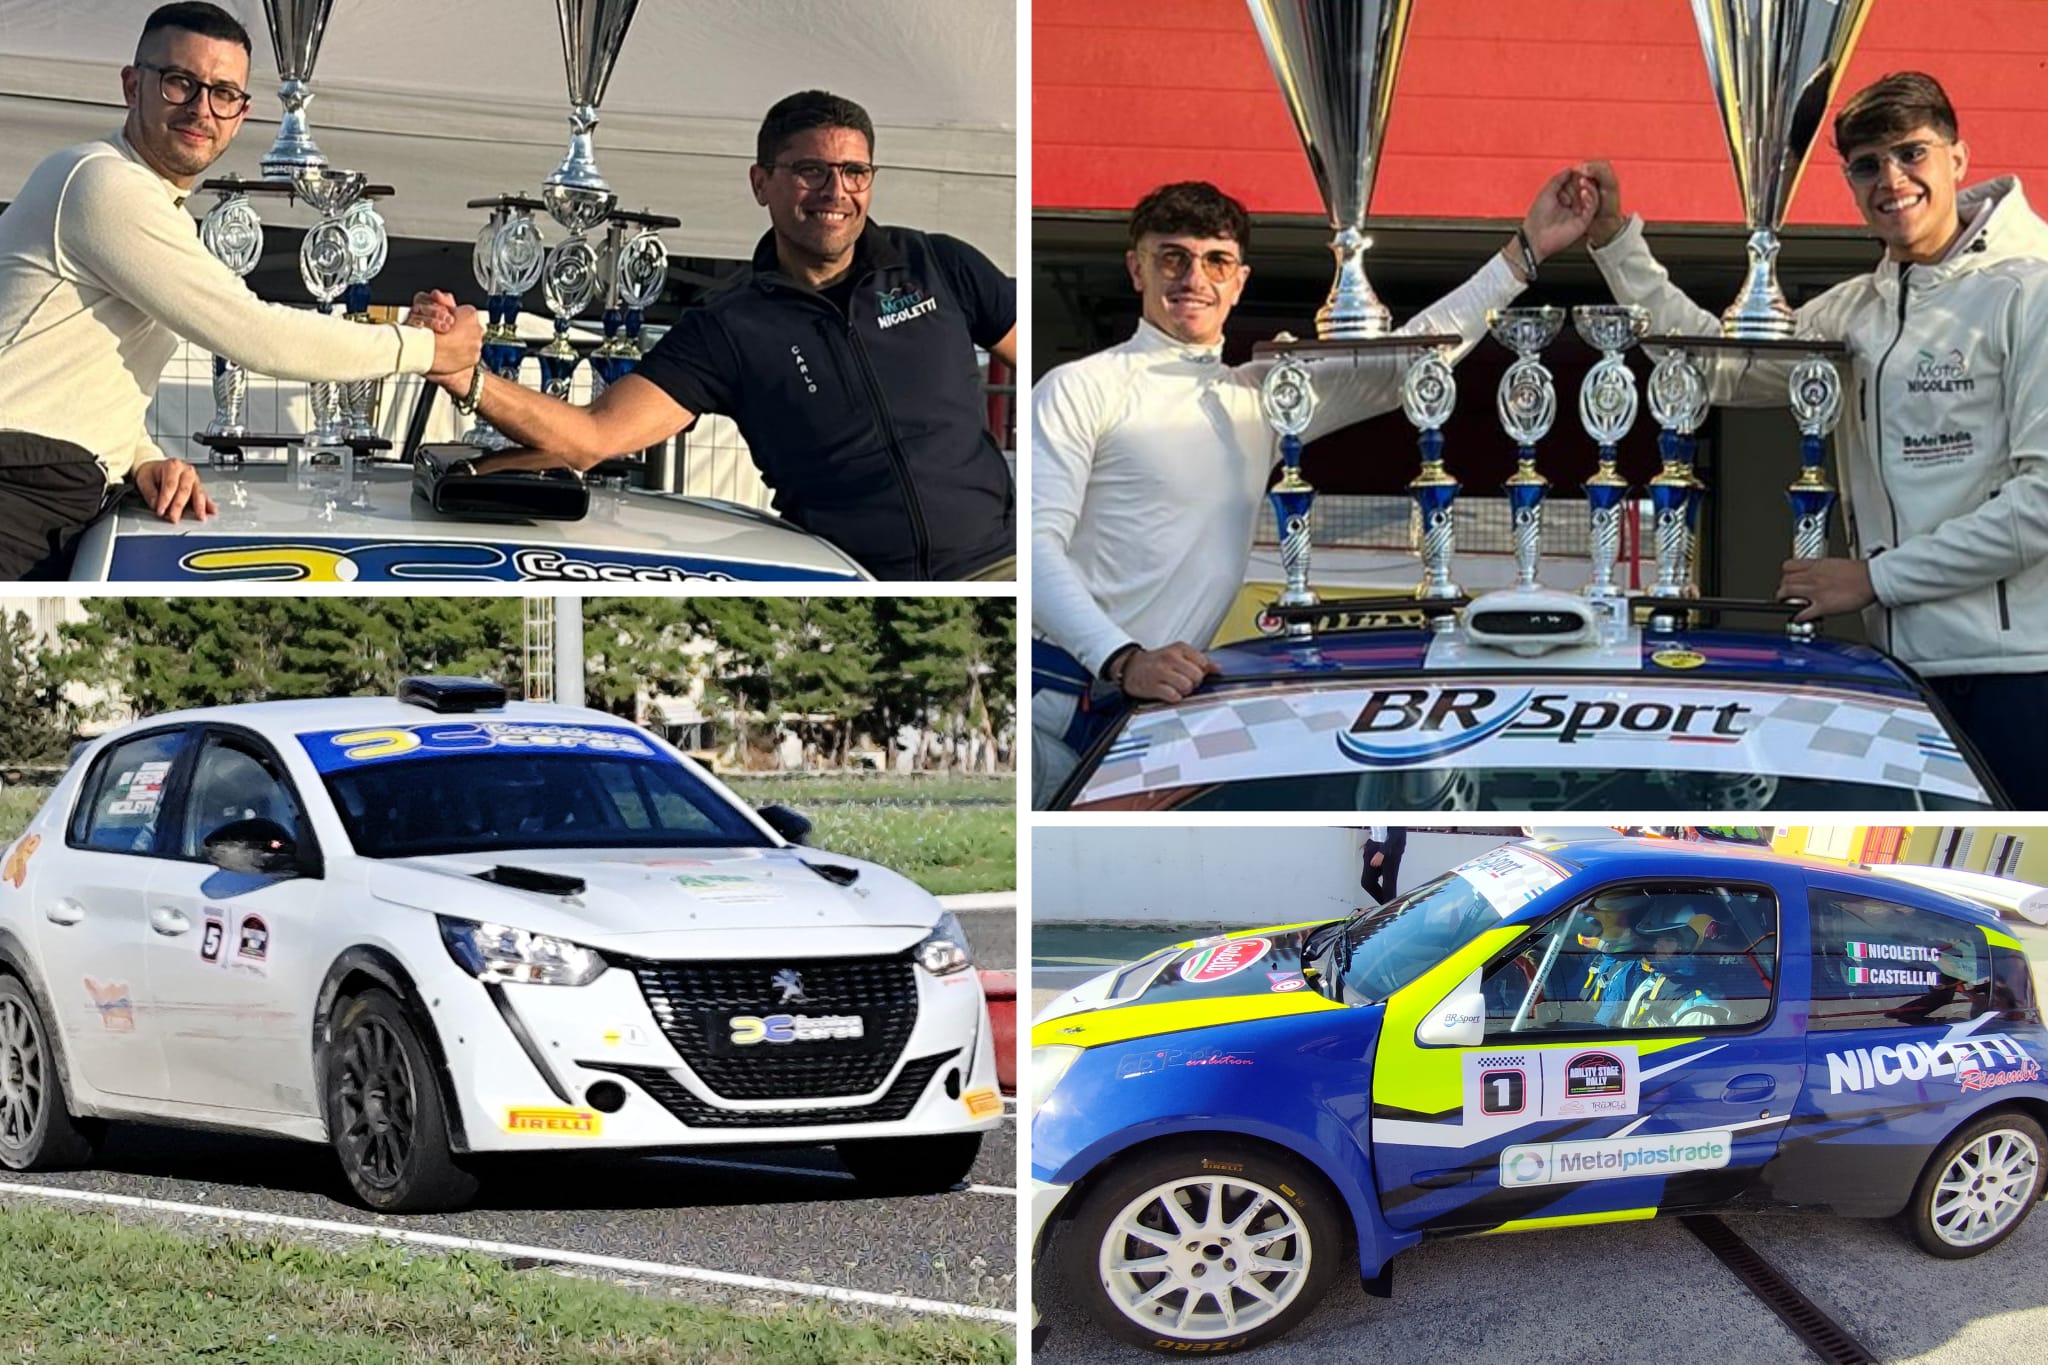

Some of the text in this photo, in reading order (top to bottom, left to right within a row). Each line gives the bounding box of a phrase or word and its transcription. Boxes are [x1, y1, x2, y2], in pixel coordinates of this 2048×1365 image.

[877, 297, 937, 330] NICOLETTI
[791, 345, 817, 393] CARLO
[1907, 378, 1975, 393] NICOLETTI
[1350, 687, 1752, 744] BR Sport
[204, 926, 220, 956] 5
[1868, 943, 1940, 962] NICOLETTI.C
[1205, 942, 1258, 973] Castelli
[1869, 968, 1938, 986] CASTELLI.M
[1445, 1013, 1480, 1024] BR Sport
[1825, 1033, 2037, 1095] NICOLETTI
[1961, 1056, 2039, 1094] Ricambi
[1492, 1078, 1510, 1107] 1
[509, 1111, 593, 1130] PIRELLI
[1560, 1141, 1723, 1172] Metalplastrade
